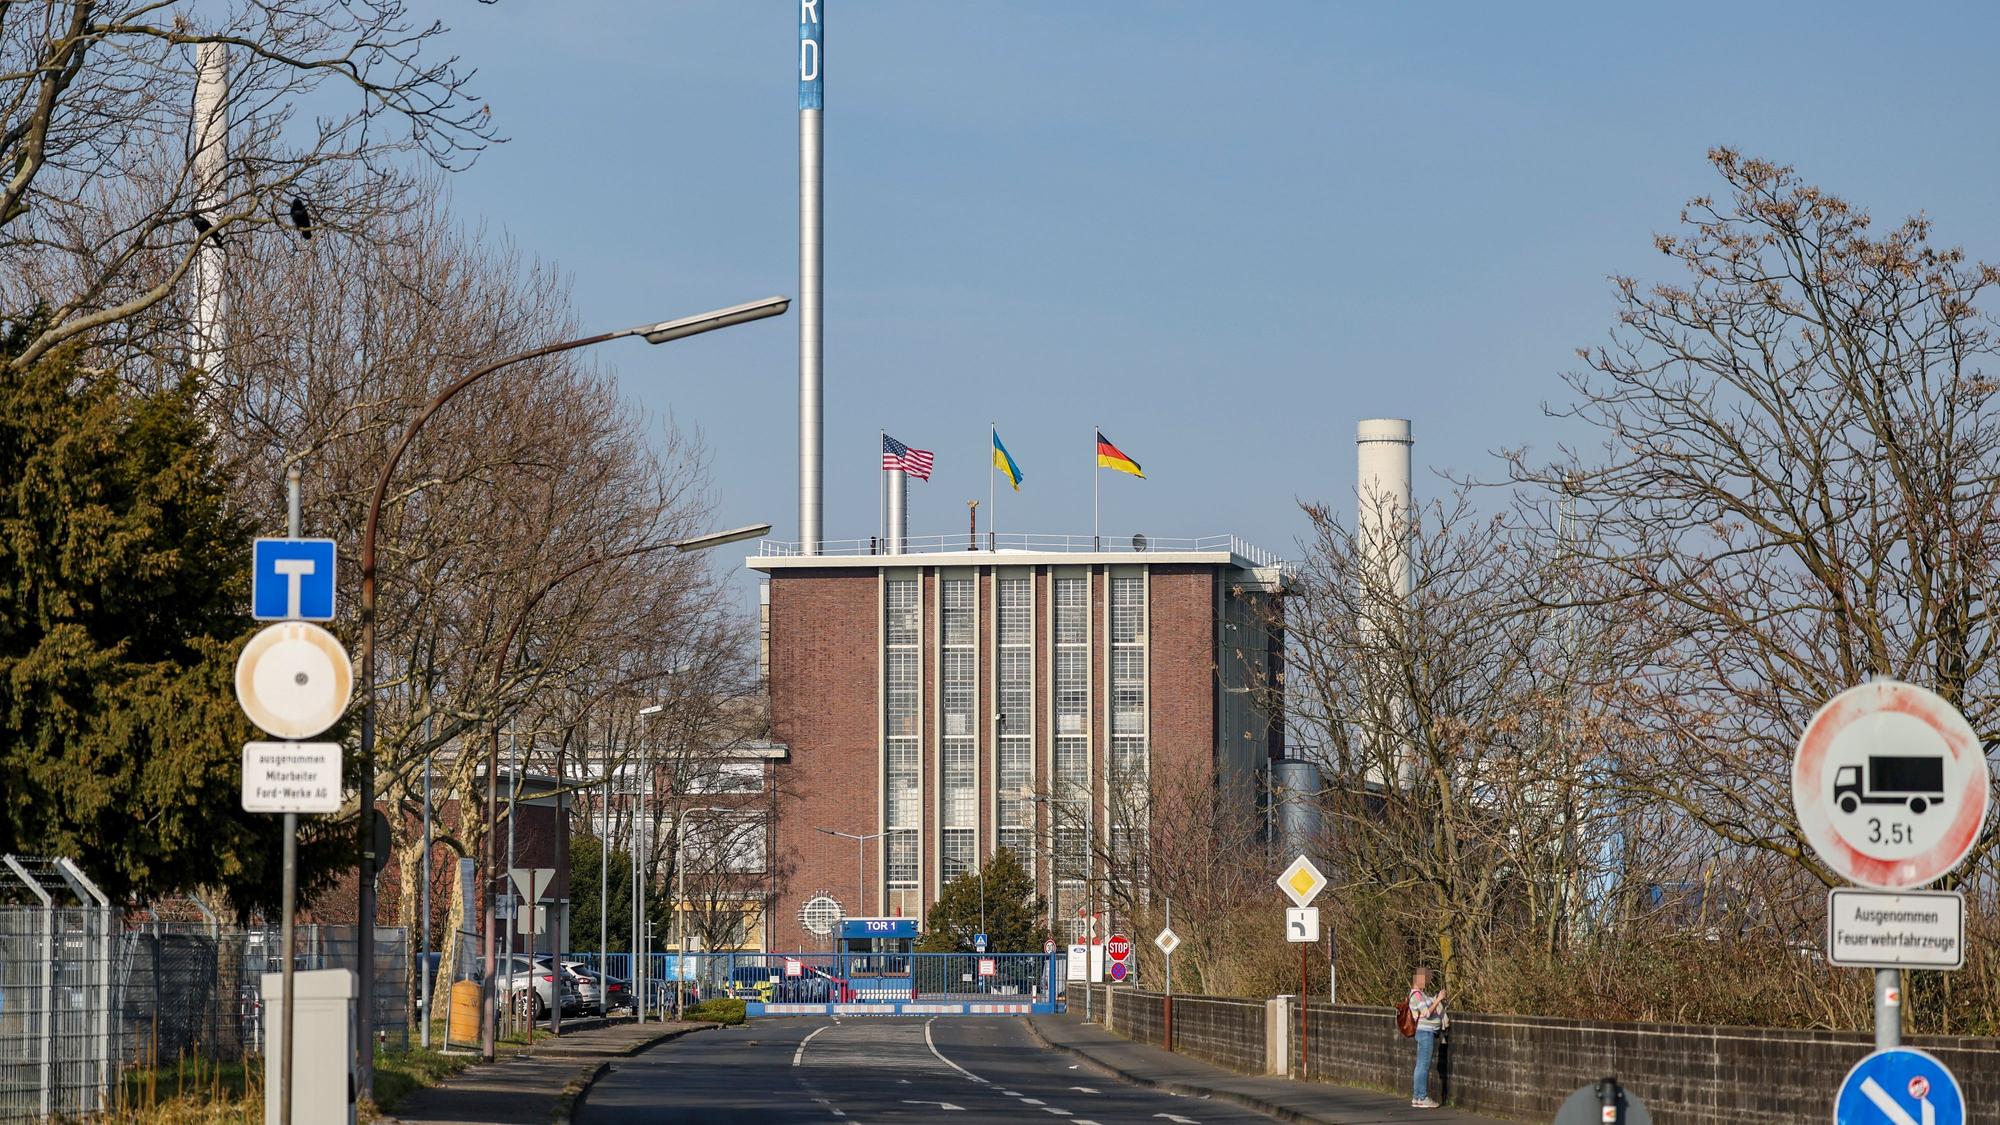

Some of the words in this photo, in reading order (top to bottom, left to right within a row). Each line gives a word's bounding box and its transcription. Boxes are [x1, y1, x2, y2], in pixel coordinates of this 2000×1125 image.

[266, 770, 317, 781] Mitarbeiter
[256, 786, 312, 799] Ford-Werke
[315, 787, 328, 799] AG
[1854, 906, 1939, 926] Ausgenommen
[866, 921, 888, 931] TOR
[891, 921, 896, 930] 1
[1837, 930, 1956, 953] Feuerwehrfahrzeuge
[1109, 942, 1128, 954] STOP
